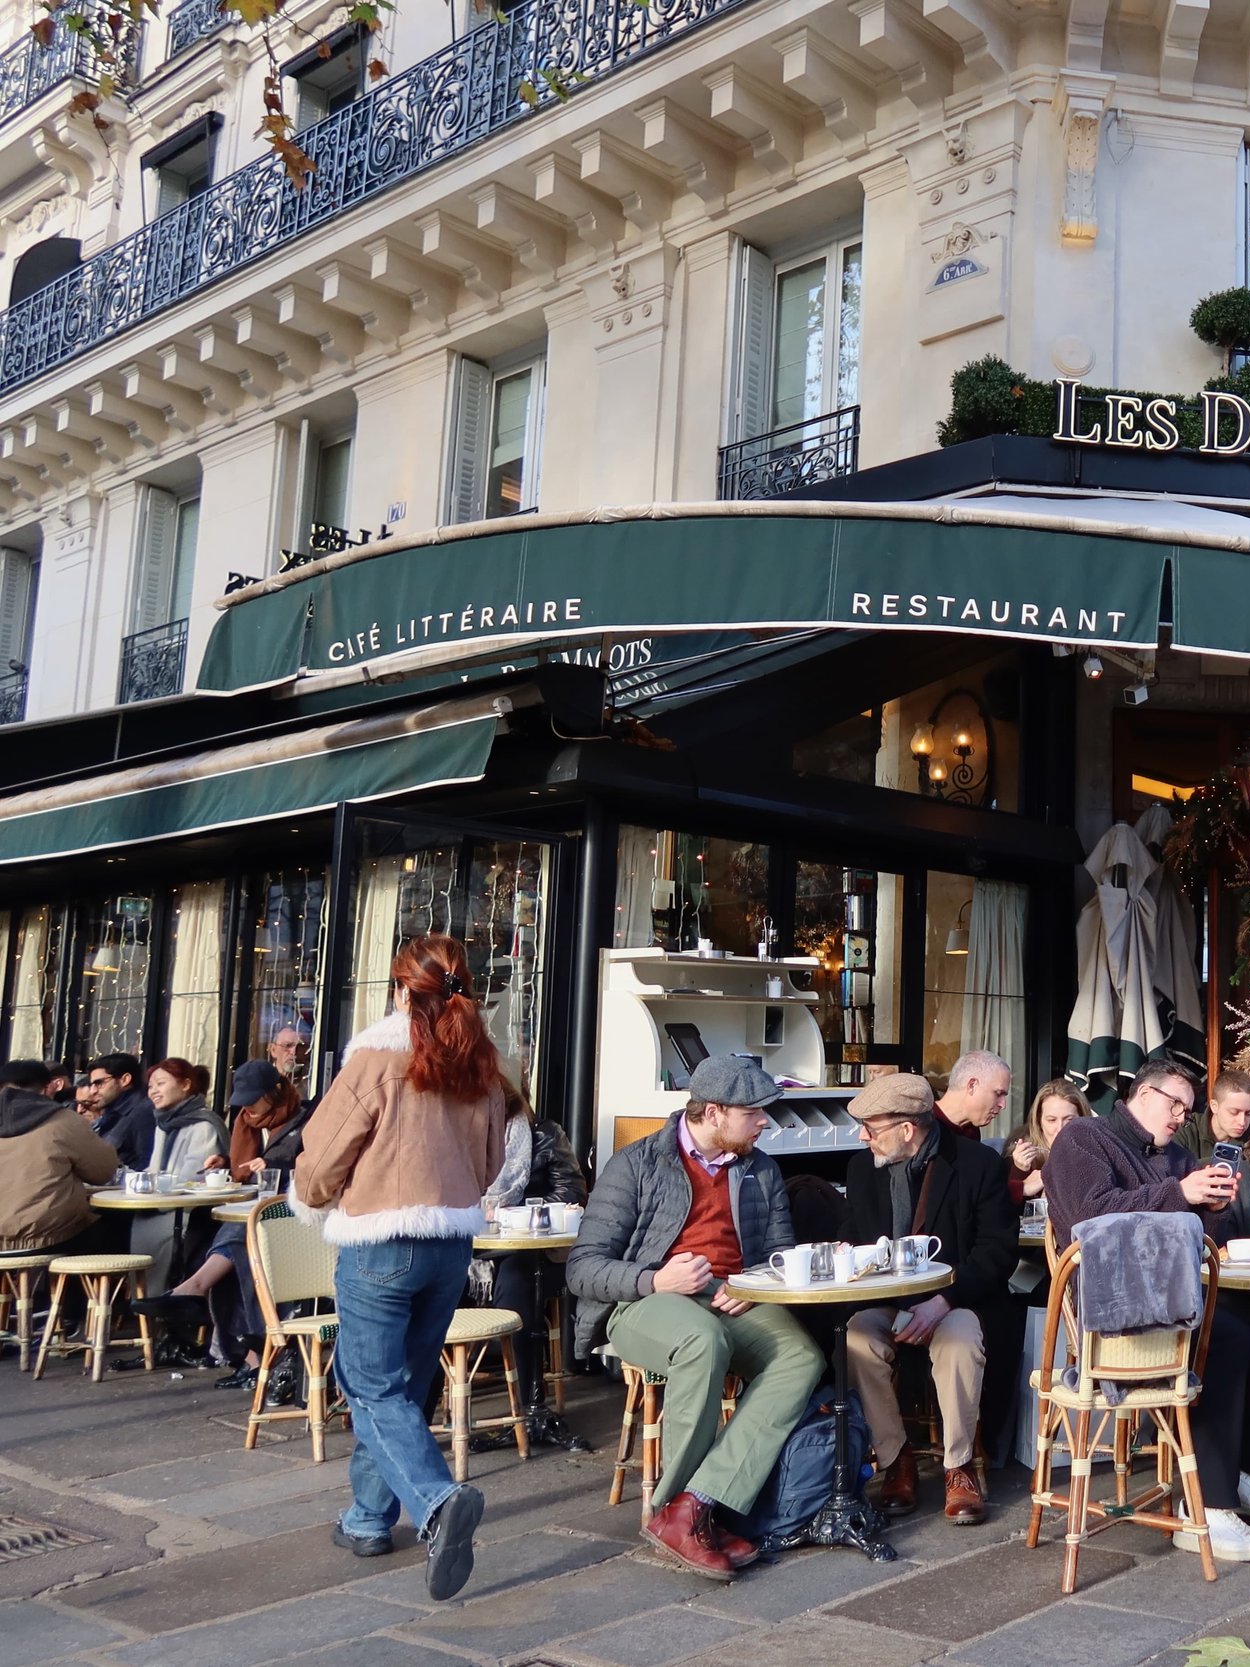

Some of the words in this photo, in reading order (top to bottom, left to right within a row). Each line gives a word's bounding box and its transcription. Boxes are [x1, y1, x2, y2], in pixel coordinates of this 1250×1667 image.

[1053, 377, 1179, 451] LES
[388, 502, 406, 522] 170
[328, 622, 382, 662] CAFÉ
[396, 598, 582, 644] LITTÉRAIRE
[852, 592, 1126, 633] RESTAURANT
